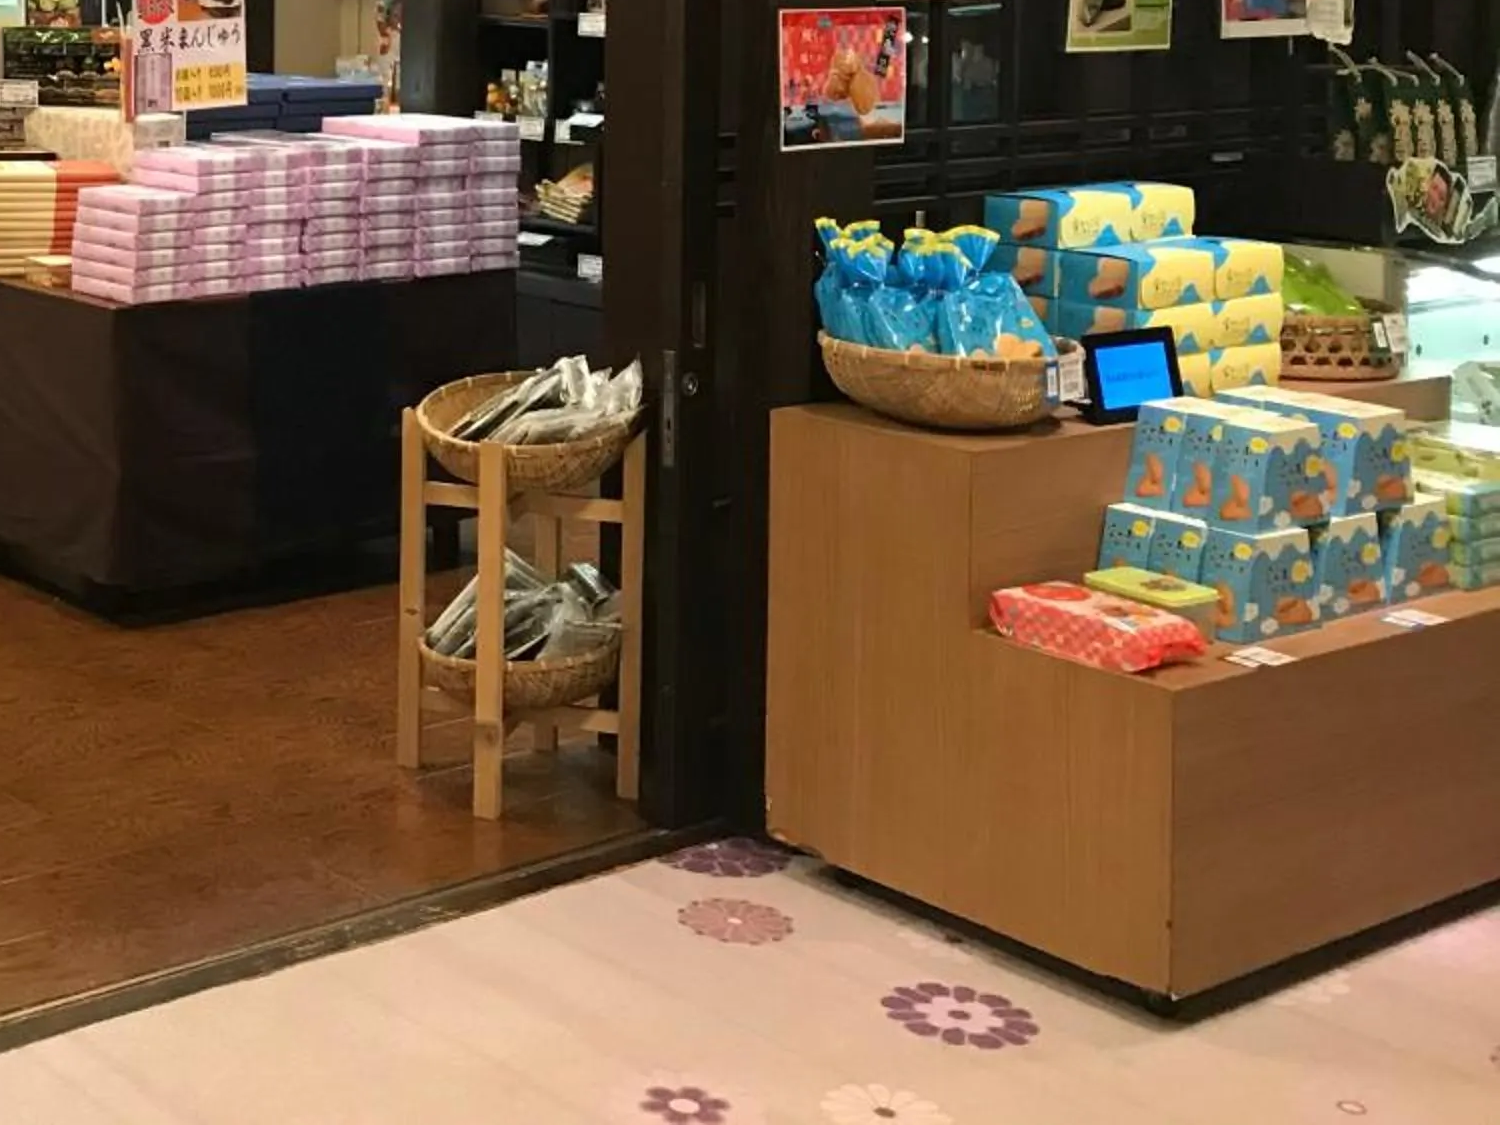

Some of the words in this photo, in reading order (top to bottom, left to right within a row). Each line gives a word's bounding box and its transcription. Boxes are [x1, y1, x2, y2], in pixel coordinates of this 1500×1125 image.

[138, 23, 241, 53] 黒米まんじゅう
